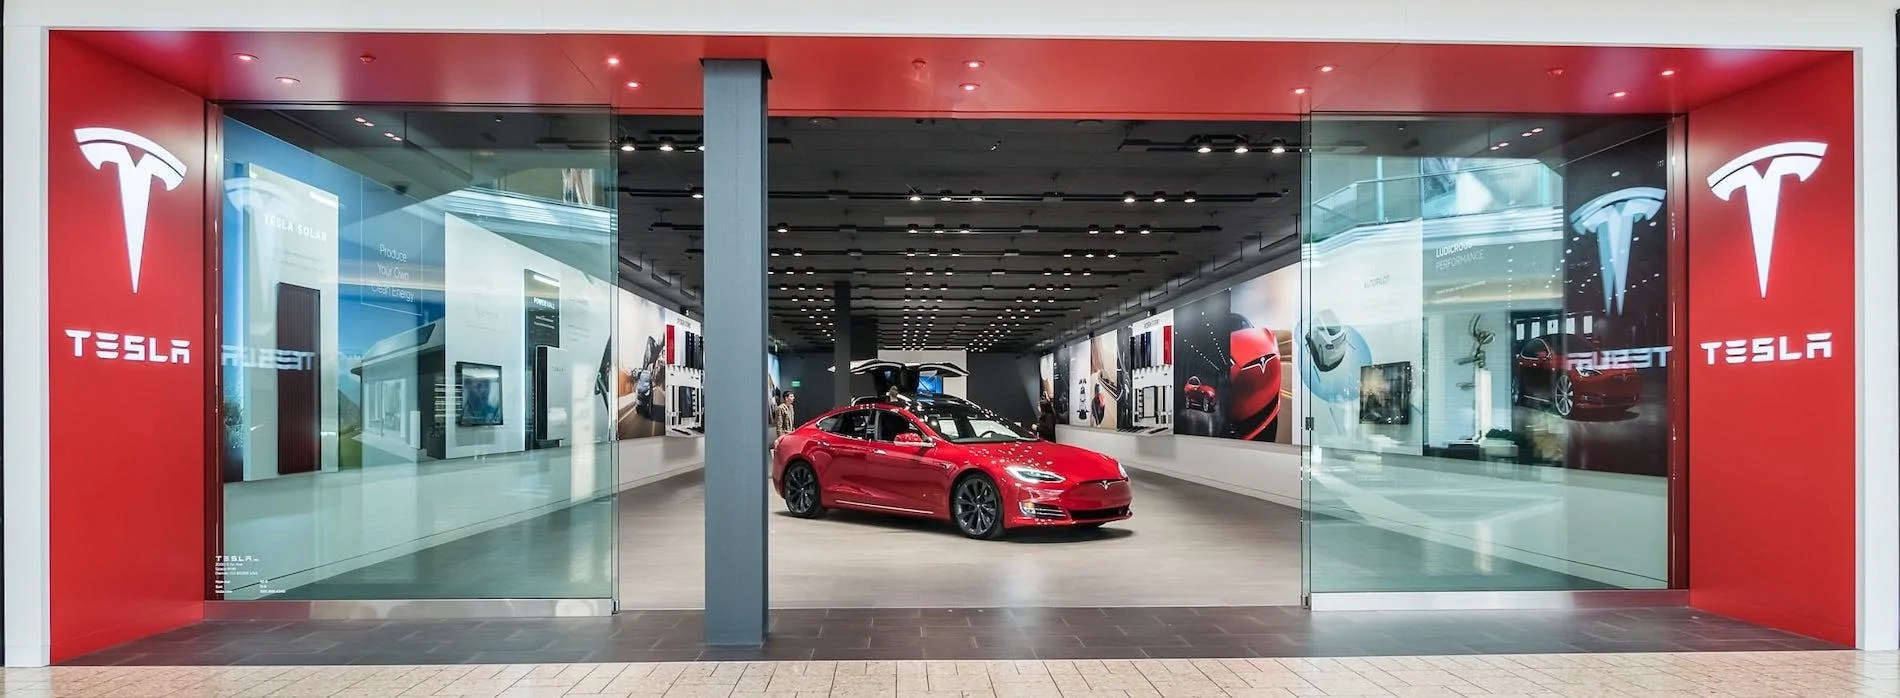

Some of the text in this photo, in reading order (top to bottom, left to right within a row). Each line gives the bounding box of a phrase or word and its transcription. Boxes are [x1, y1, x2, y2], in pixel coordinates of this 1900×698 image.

[263, 214, 328, 242] TESLA SOLAR
[379, 243, 408, 263] Produce
[377, 262, 410, 280] Your Own
[392, 287, 415, 303] Energy
[64, 329, 191, 364] TESLA
[1700, 332, 1832, 365] TESLA
